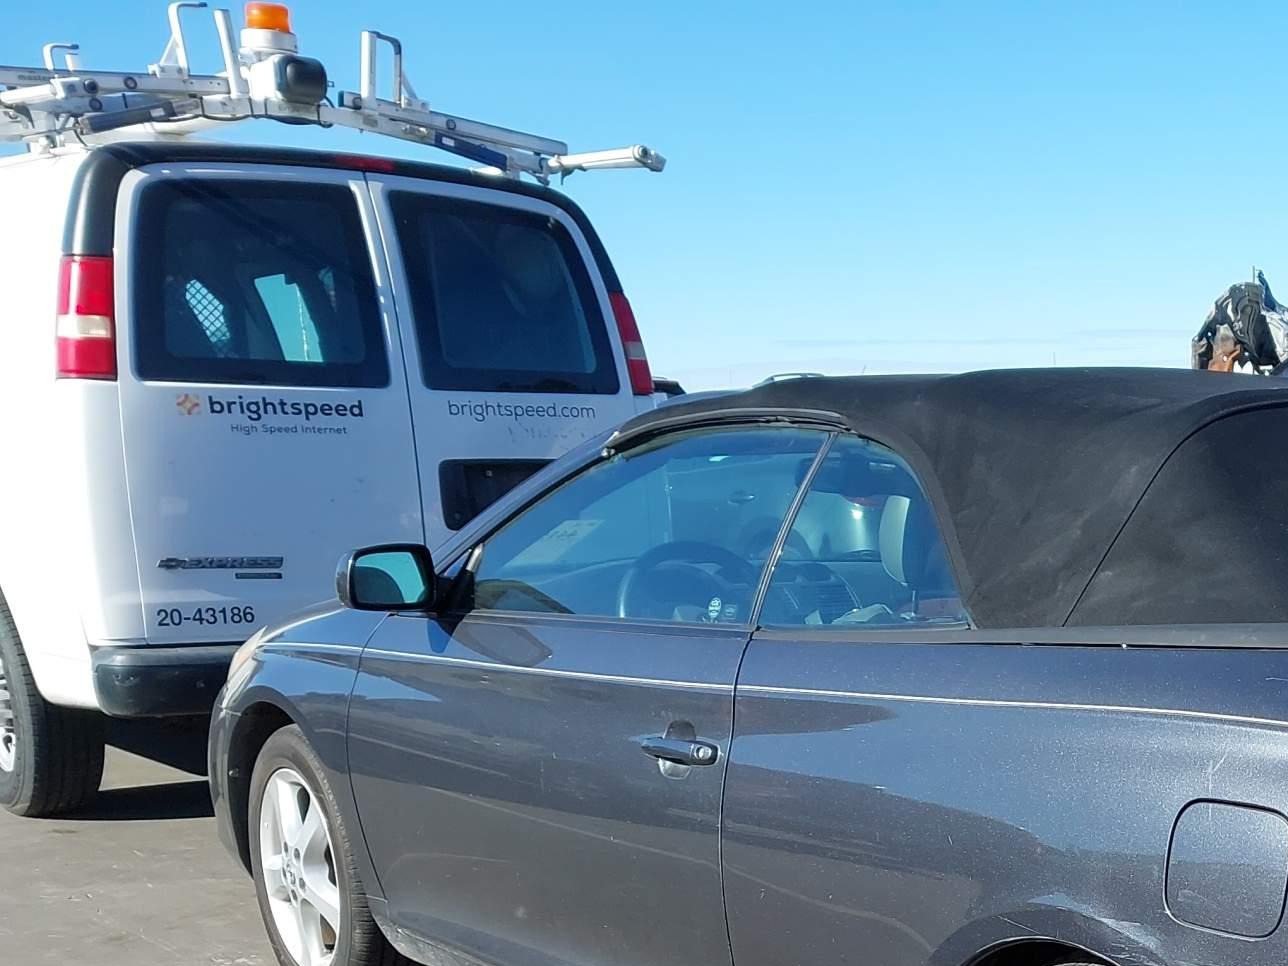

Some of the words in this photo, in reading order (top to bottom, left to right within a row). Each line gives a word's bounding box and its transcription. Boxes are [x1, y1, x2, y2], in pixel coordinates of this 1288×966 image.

[208, 395, 364, 421] brightspeed
[447, 400, 596, 422] brightspeed.com
[230, 424, 258, 435] High
[261, 424, 298, 435] Speed
[301, 426, 347, 434] Internet
[180, 556, 284, 570] EXPRESS
[156, 606, 256, 627] 20-43186
